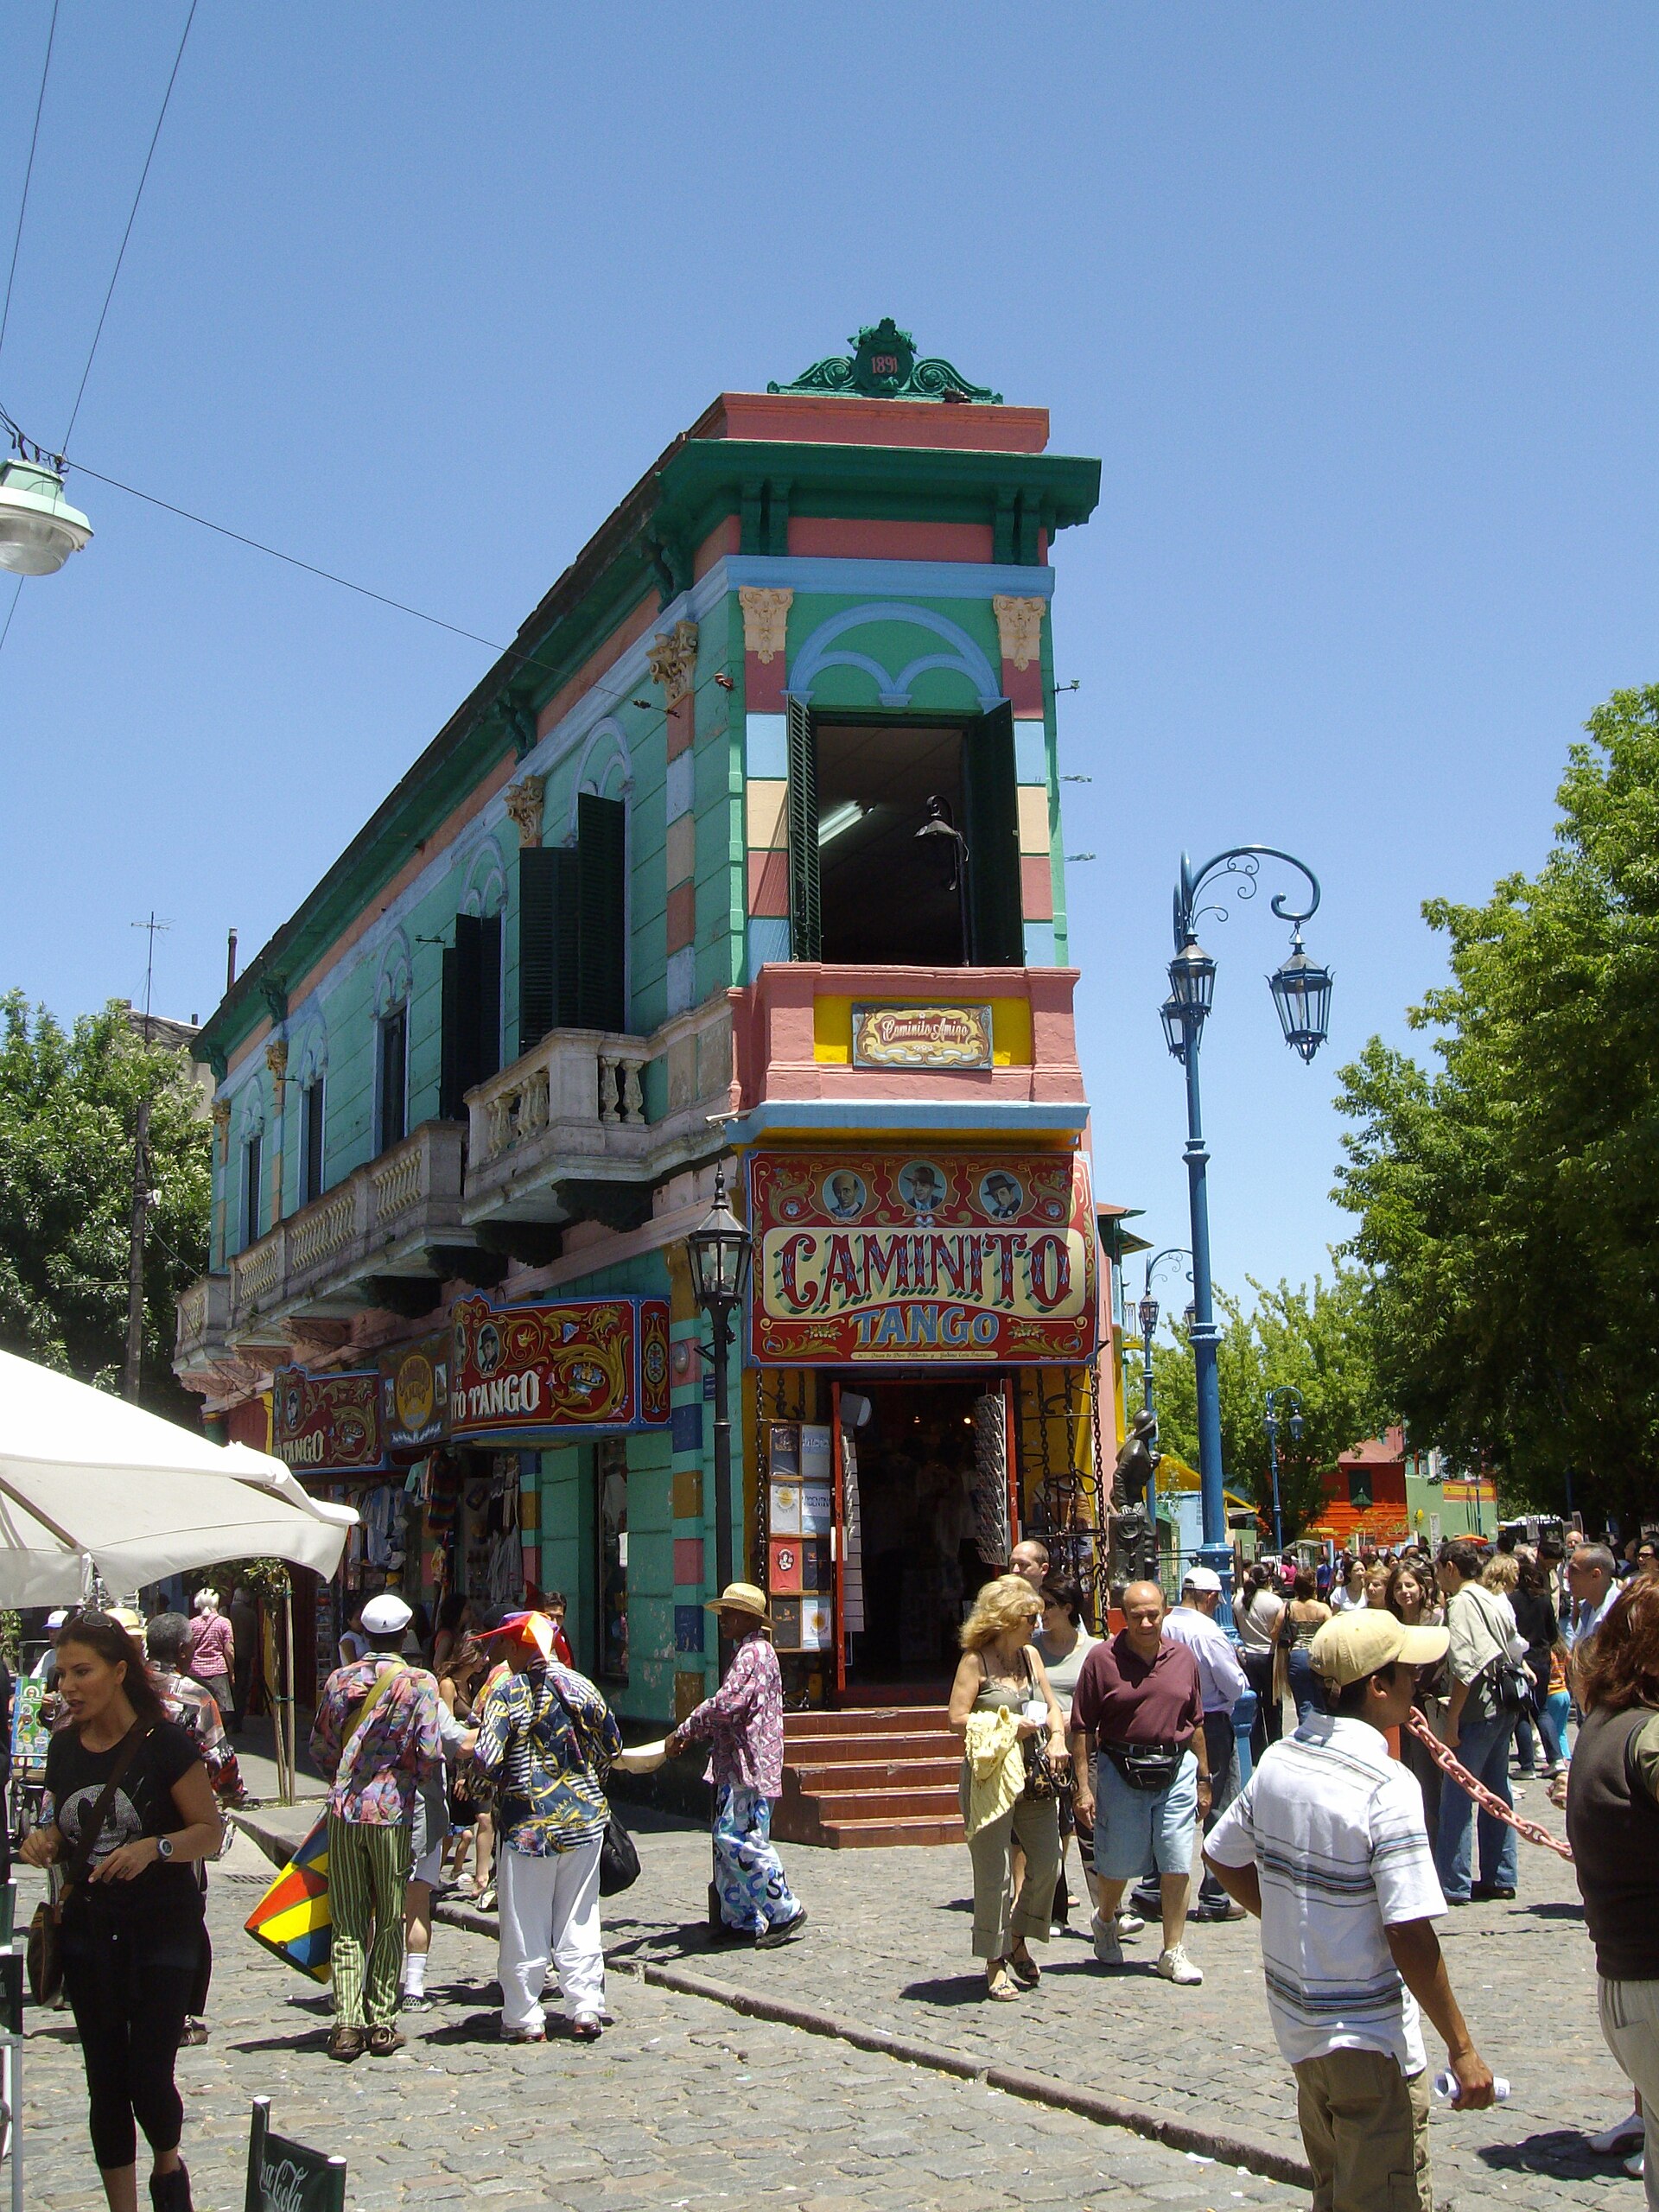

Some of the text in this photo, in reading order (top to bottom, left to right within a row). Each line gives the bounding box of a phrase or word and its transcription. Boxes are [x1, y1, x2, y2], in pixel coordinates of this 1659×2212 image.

[871, 356, 898, 374] 1891
[882, 1018, 969, 1045] Caminito Amigo
[775, 1232, 1073, 1311] CAMINITO
[850, 1304, 1000, 1346] TANGO
[467, 1370, 541, 1417] TANGO
[283, 1429, 325, 1463] TANGO
